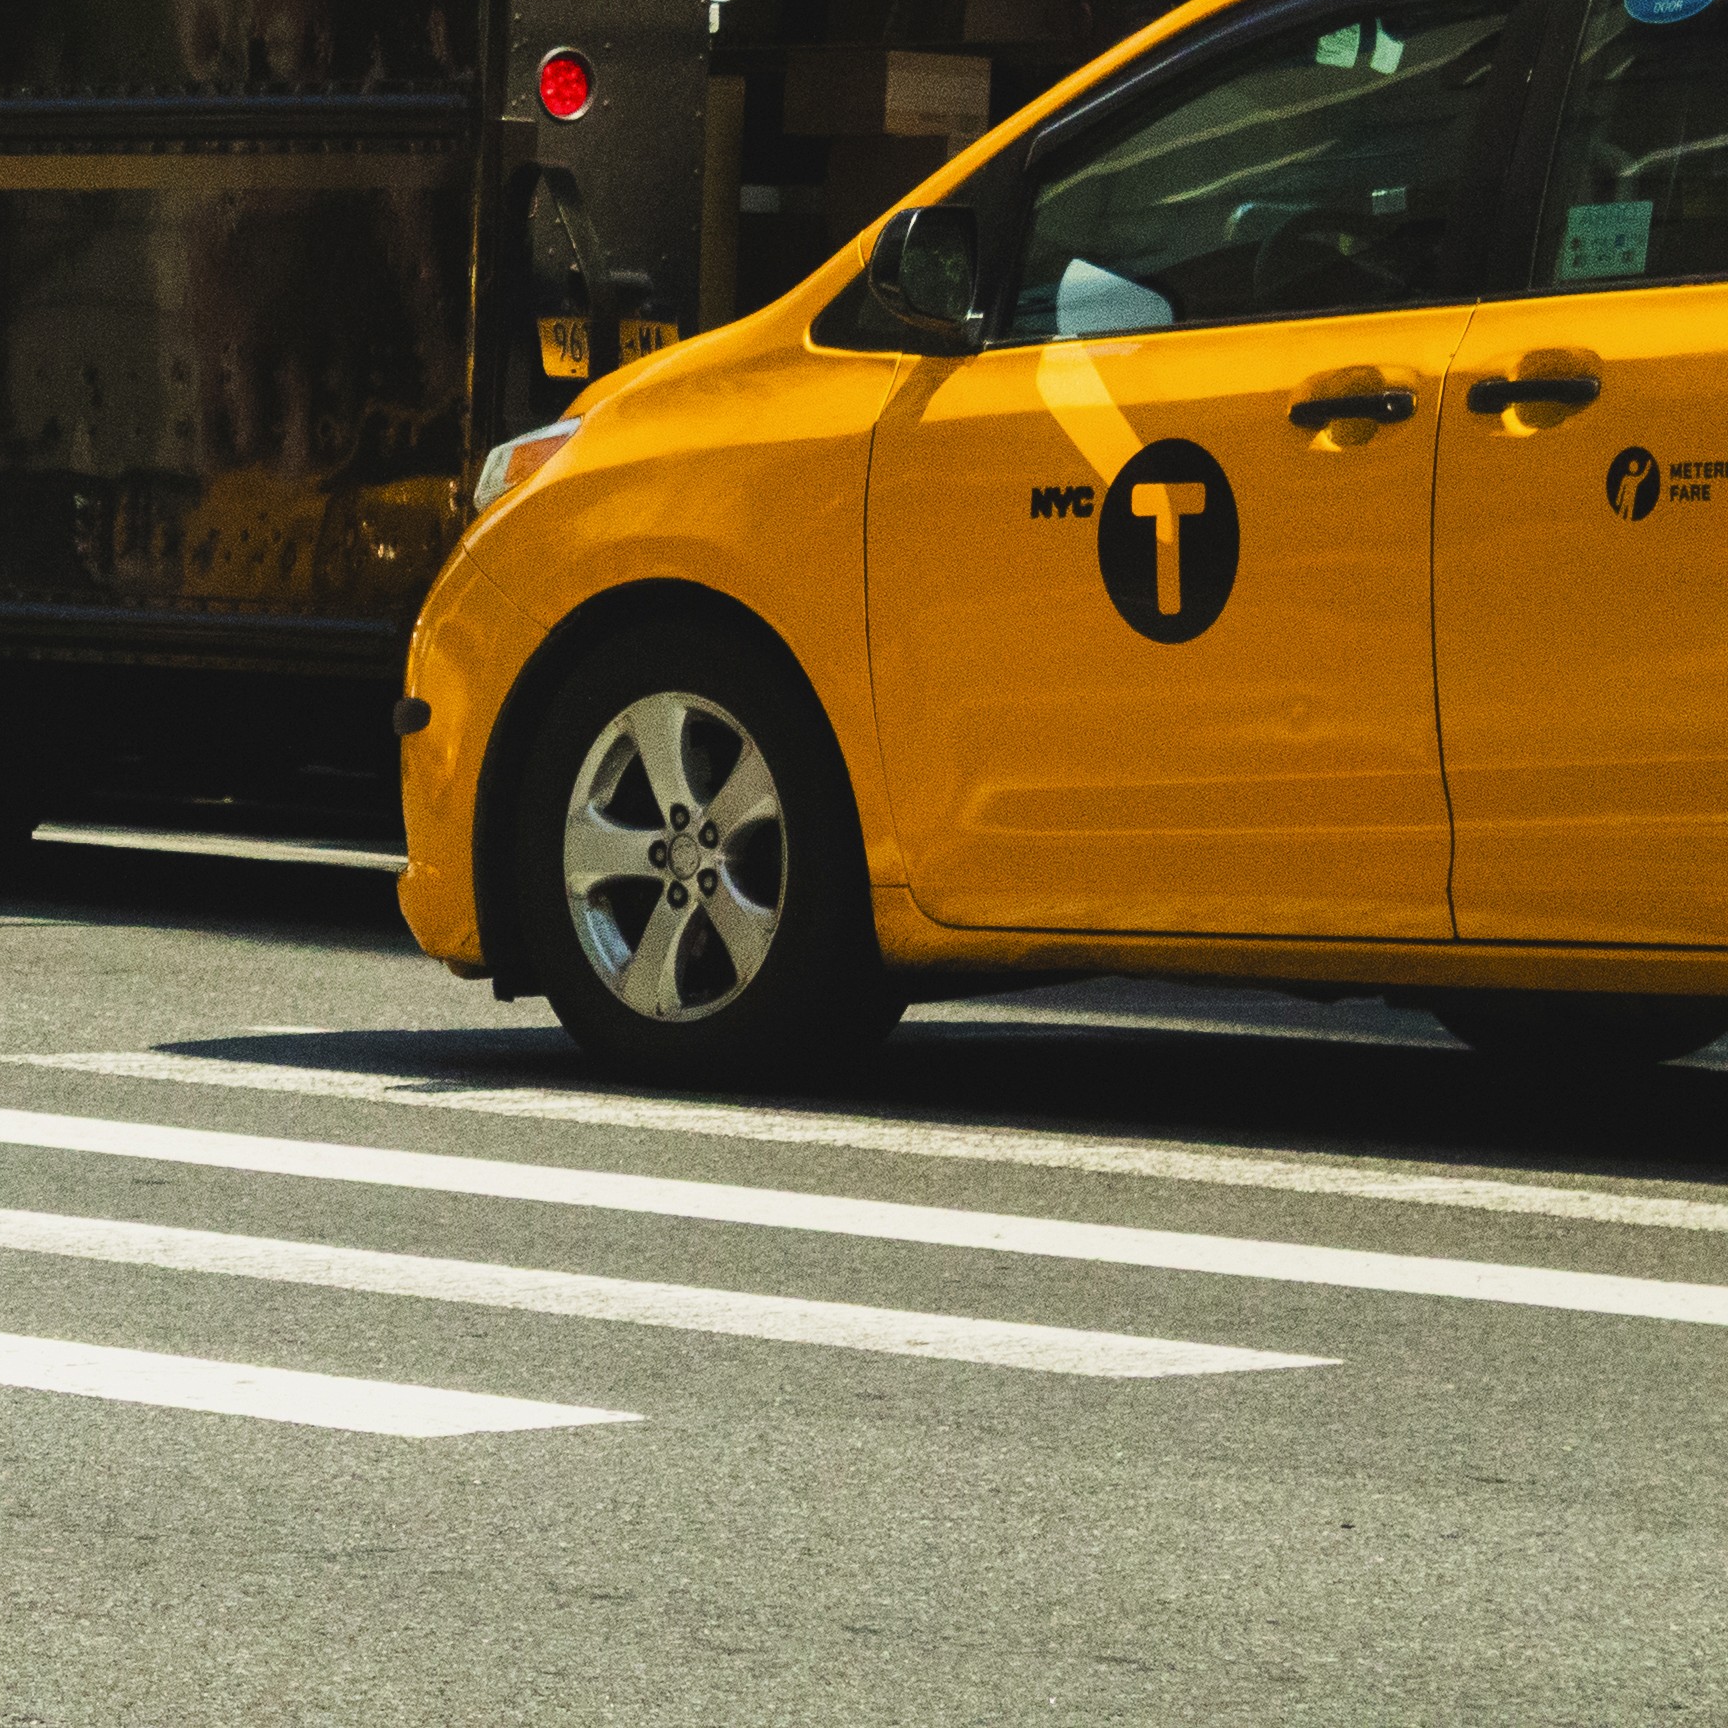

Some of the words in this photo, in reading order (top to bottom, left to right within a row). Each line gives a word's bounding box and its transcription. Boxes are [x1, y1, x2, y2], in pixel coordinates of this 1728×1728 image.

[1669, 460, 1728, 480] METER
[1029, 485, 1094, 519] NYC
[1669, 484, 1710, 502] FARE
